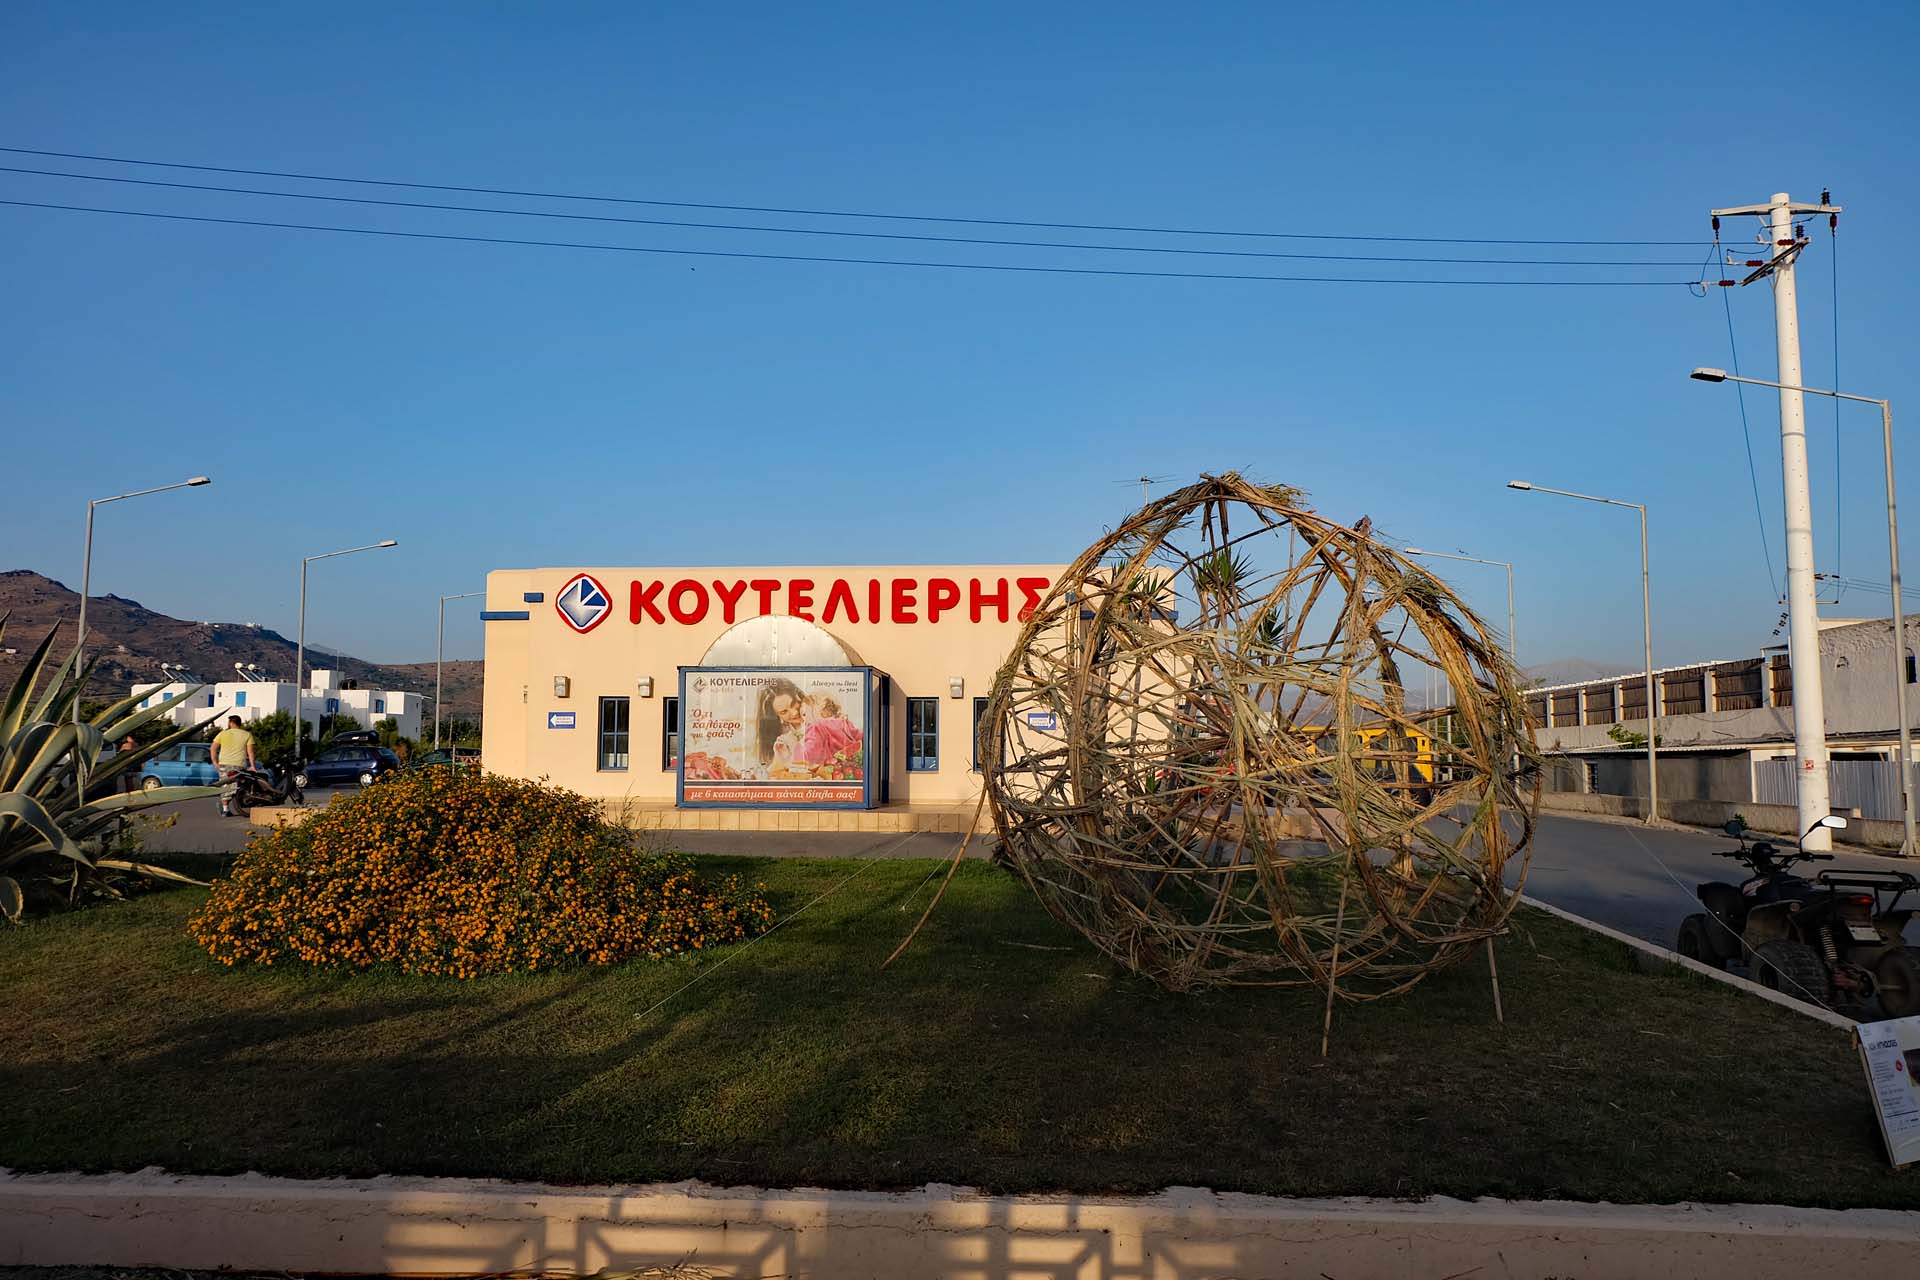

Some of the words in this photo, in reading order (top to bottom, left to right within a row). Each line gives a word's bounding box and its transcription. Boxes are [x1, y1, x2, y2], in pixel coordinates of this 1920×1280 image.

[629, 577, 1050, 624] ΚΟΥΤΕΛΙΕΡΗΣ
[710, 678, 777, 686] ΚΟΥΤΕΛΙΕΡΗΣ
[692, 720, 741, 731] καλύτερο
[691, 791, 703, 800] με
[705, 791, 711, 799] 6
[712, 790, 773, 800] καταστήματα
[776, 790, 804, 799] πάντα
[805, 790, 833, 800] δίπλα
[836, 790, 857, 800] σας!
